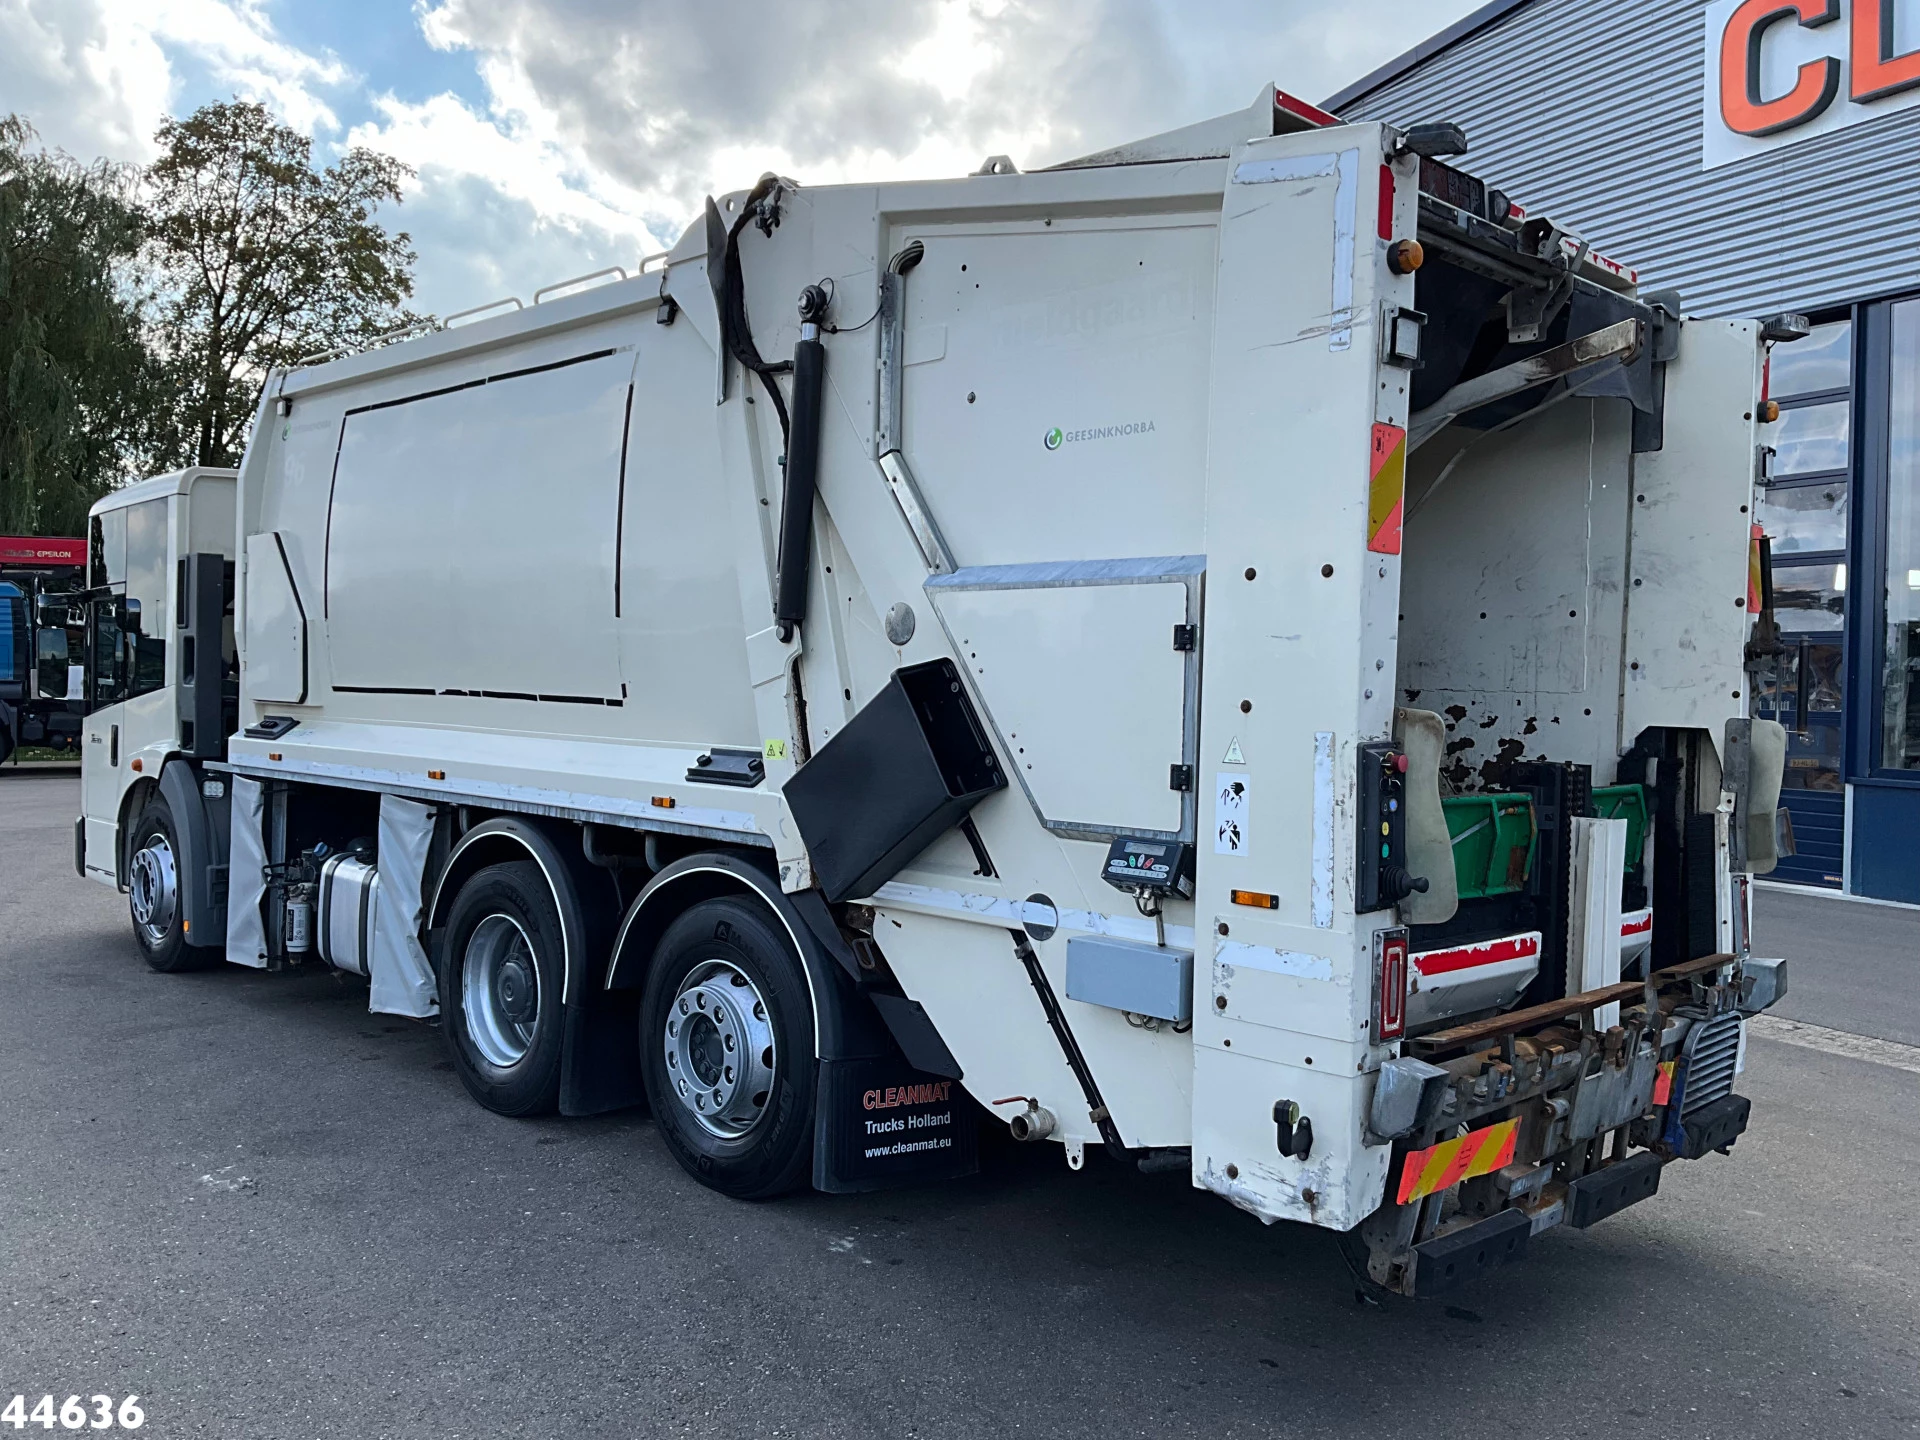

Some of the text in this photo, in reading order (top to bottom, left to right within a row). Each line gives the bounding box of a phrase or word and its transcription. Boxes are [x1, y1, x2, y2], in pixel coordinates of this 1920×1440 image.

[1065, 420, 1155, 442] GEESINKNORBA
[37, 550, 71, 558] EPSILON
[863, 1081, 951, 1110] CLEANMAT
[865, 1111, 950, 1134] Trucks Holland
[865, 1137, 952, 1158] www.cleanmat.eu
